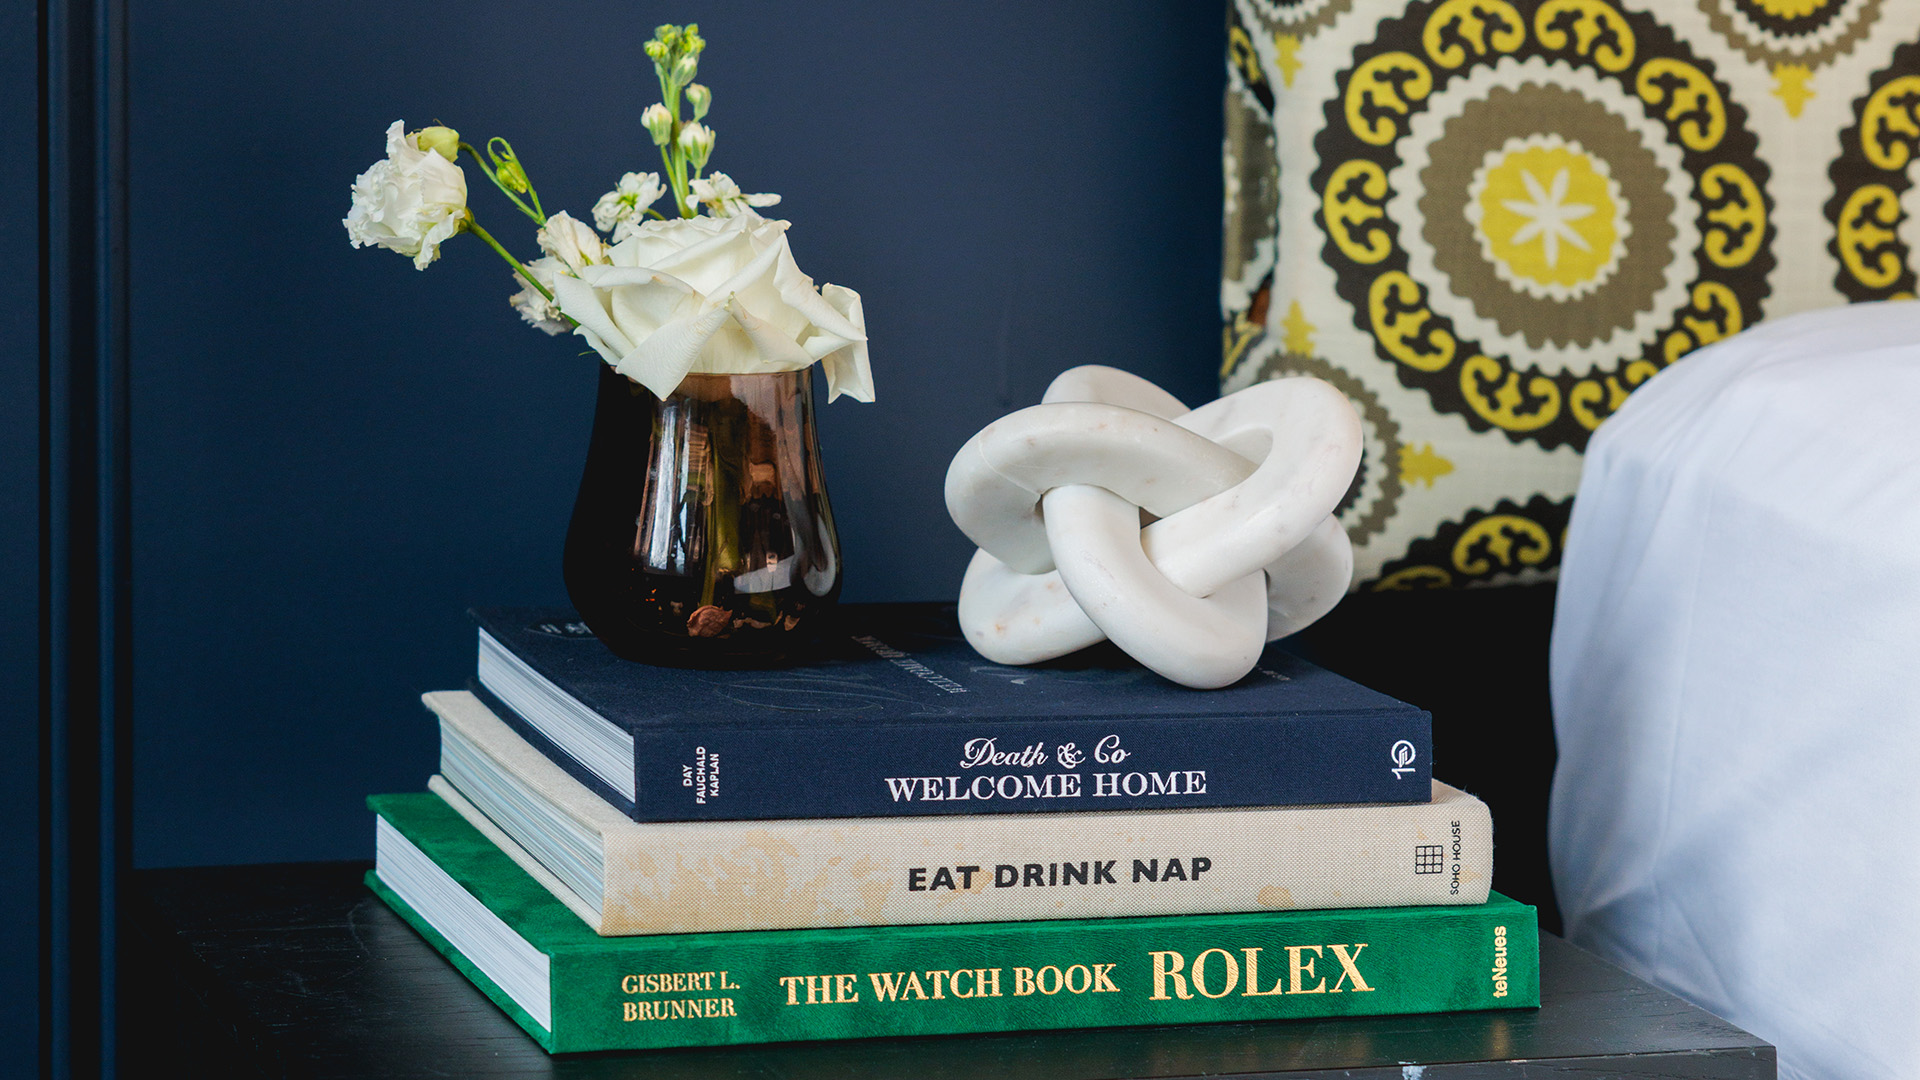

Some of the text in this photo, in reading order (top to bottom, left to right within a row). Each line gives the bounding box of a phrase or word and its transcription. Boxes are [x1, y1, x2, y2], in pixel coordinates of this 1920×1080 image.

[959, 734, 1131, 769] Death & Co
[682, 764, 693, 787] DAY
[696, 746, 706, 804] FAUCHALD
[709, 753, 719, 797] KAPLAN
[884, 770, 1207, 802] WELCOME HOME
[908, 857, 1213, 892] EAT DRINK NAP
[1450, 820, 1461, 895] SOHO HOUSE
[779, 943, 1376, 1005] THE WATCH BOOK ROLEX
[1492, 926, 1507, 998] teNeues
[621, 970, 741, 994] GISBERT L.
[622, 997, 737, 1022] BRUNNER
